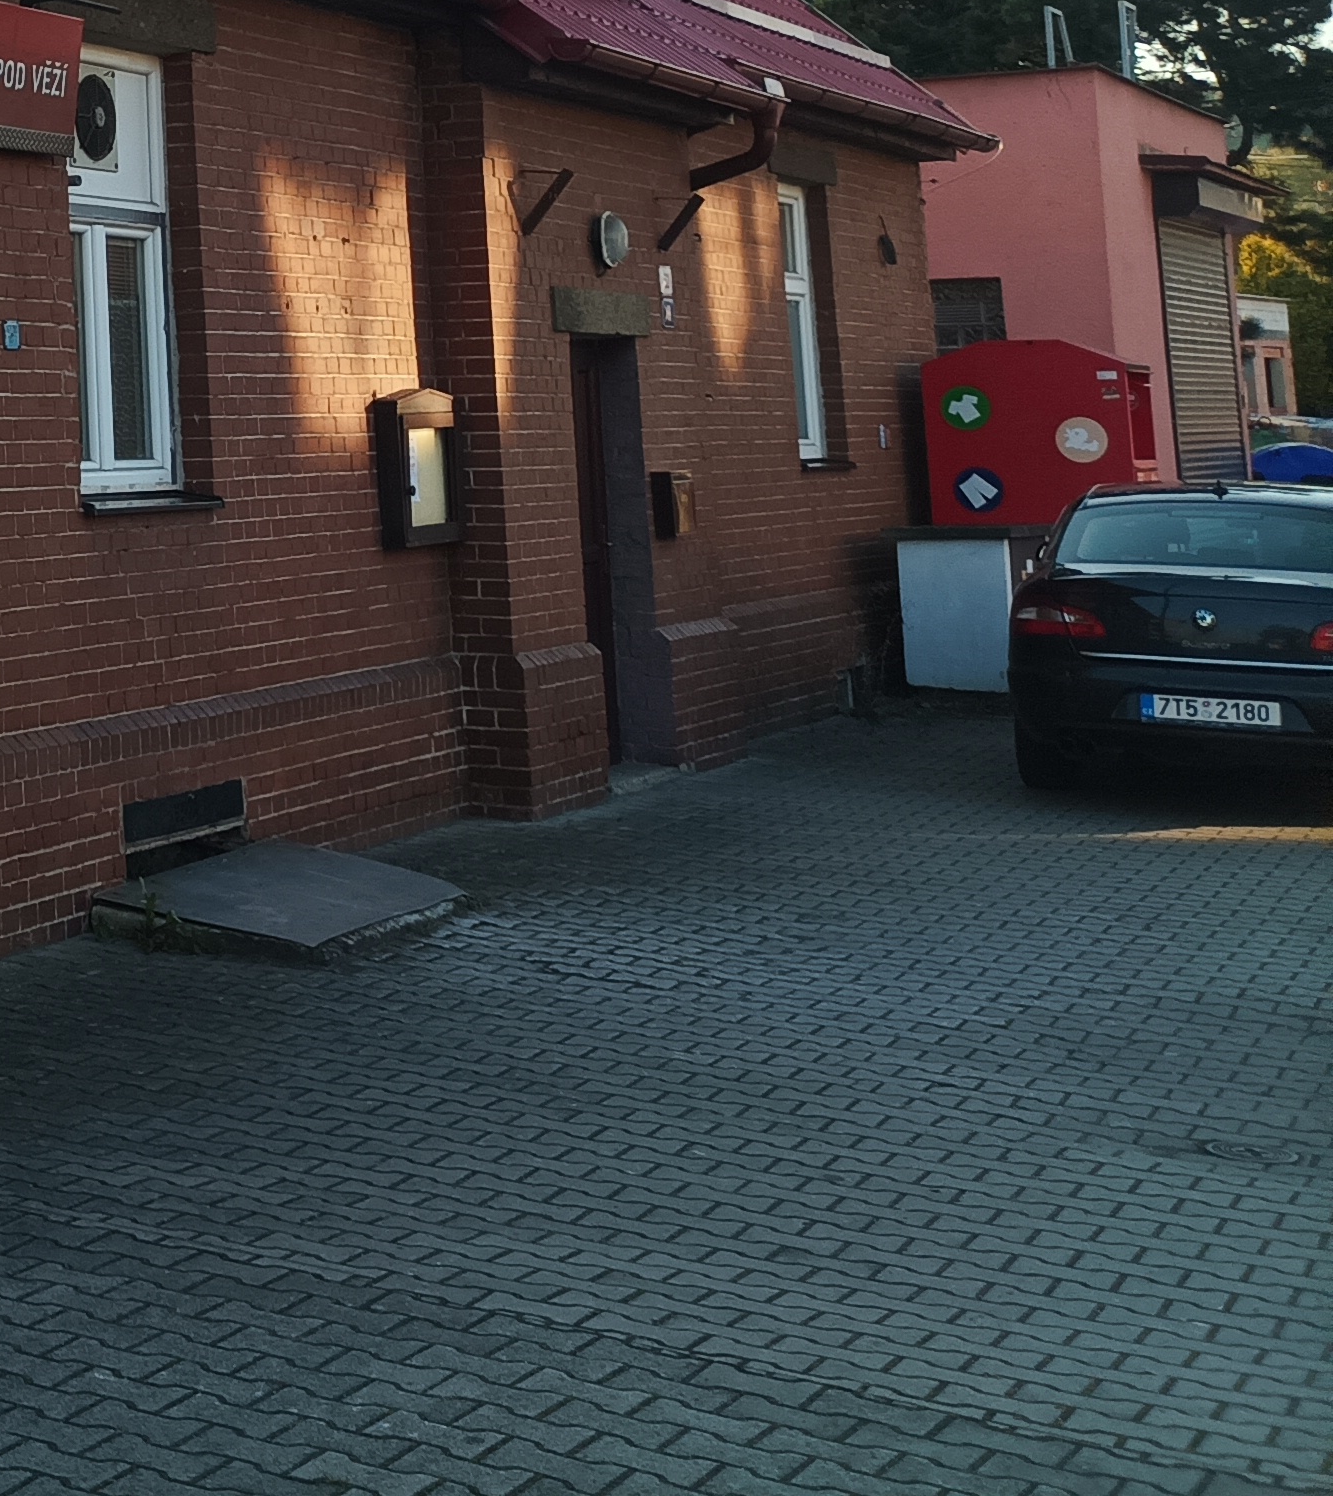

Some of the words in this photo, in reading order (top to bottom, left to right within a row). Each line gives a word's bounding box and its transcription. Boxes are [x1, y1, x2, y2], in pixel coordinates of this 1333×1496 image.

[32, 60, 69, 98] VĚŽÍ
[1159, 697, 1198, 717] 7T5
[1216, 701, 1270, 722] 2180
